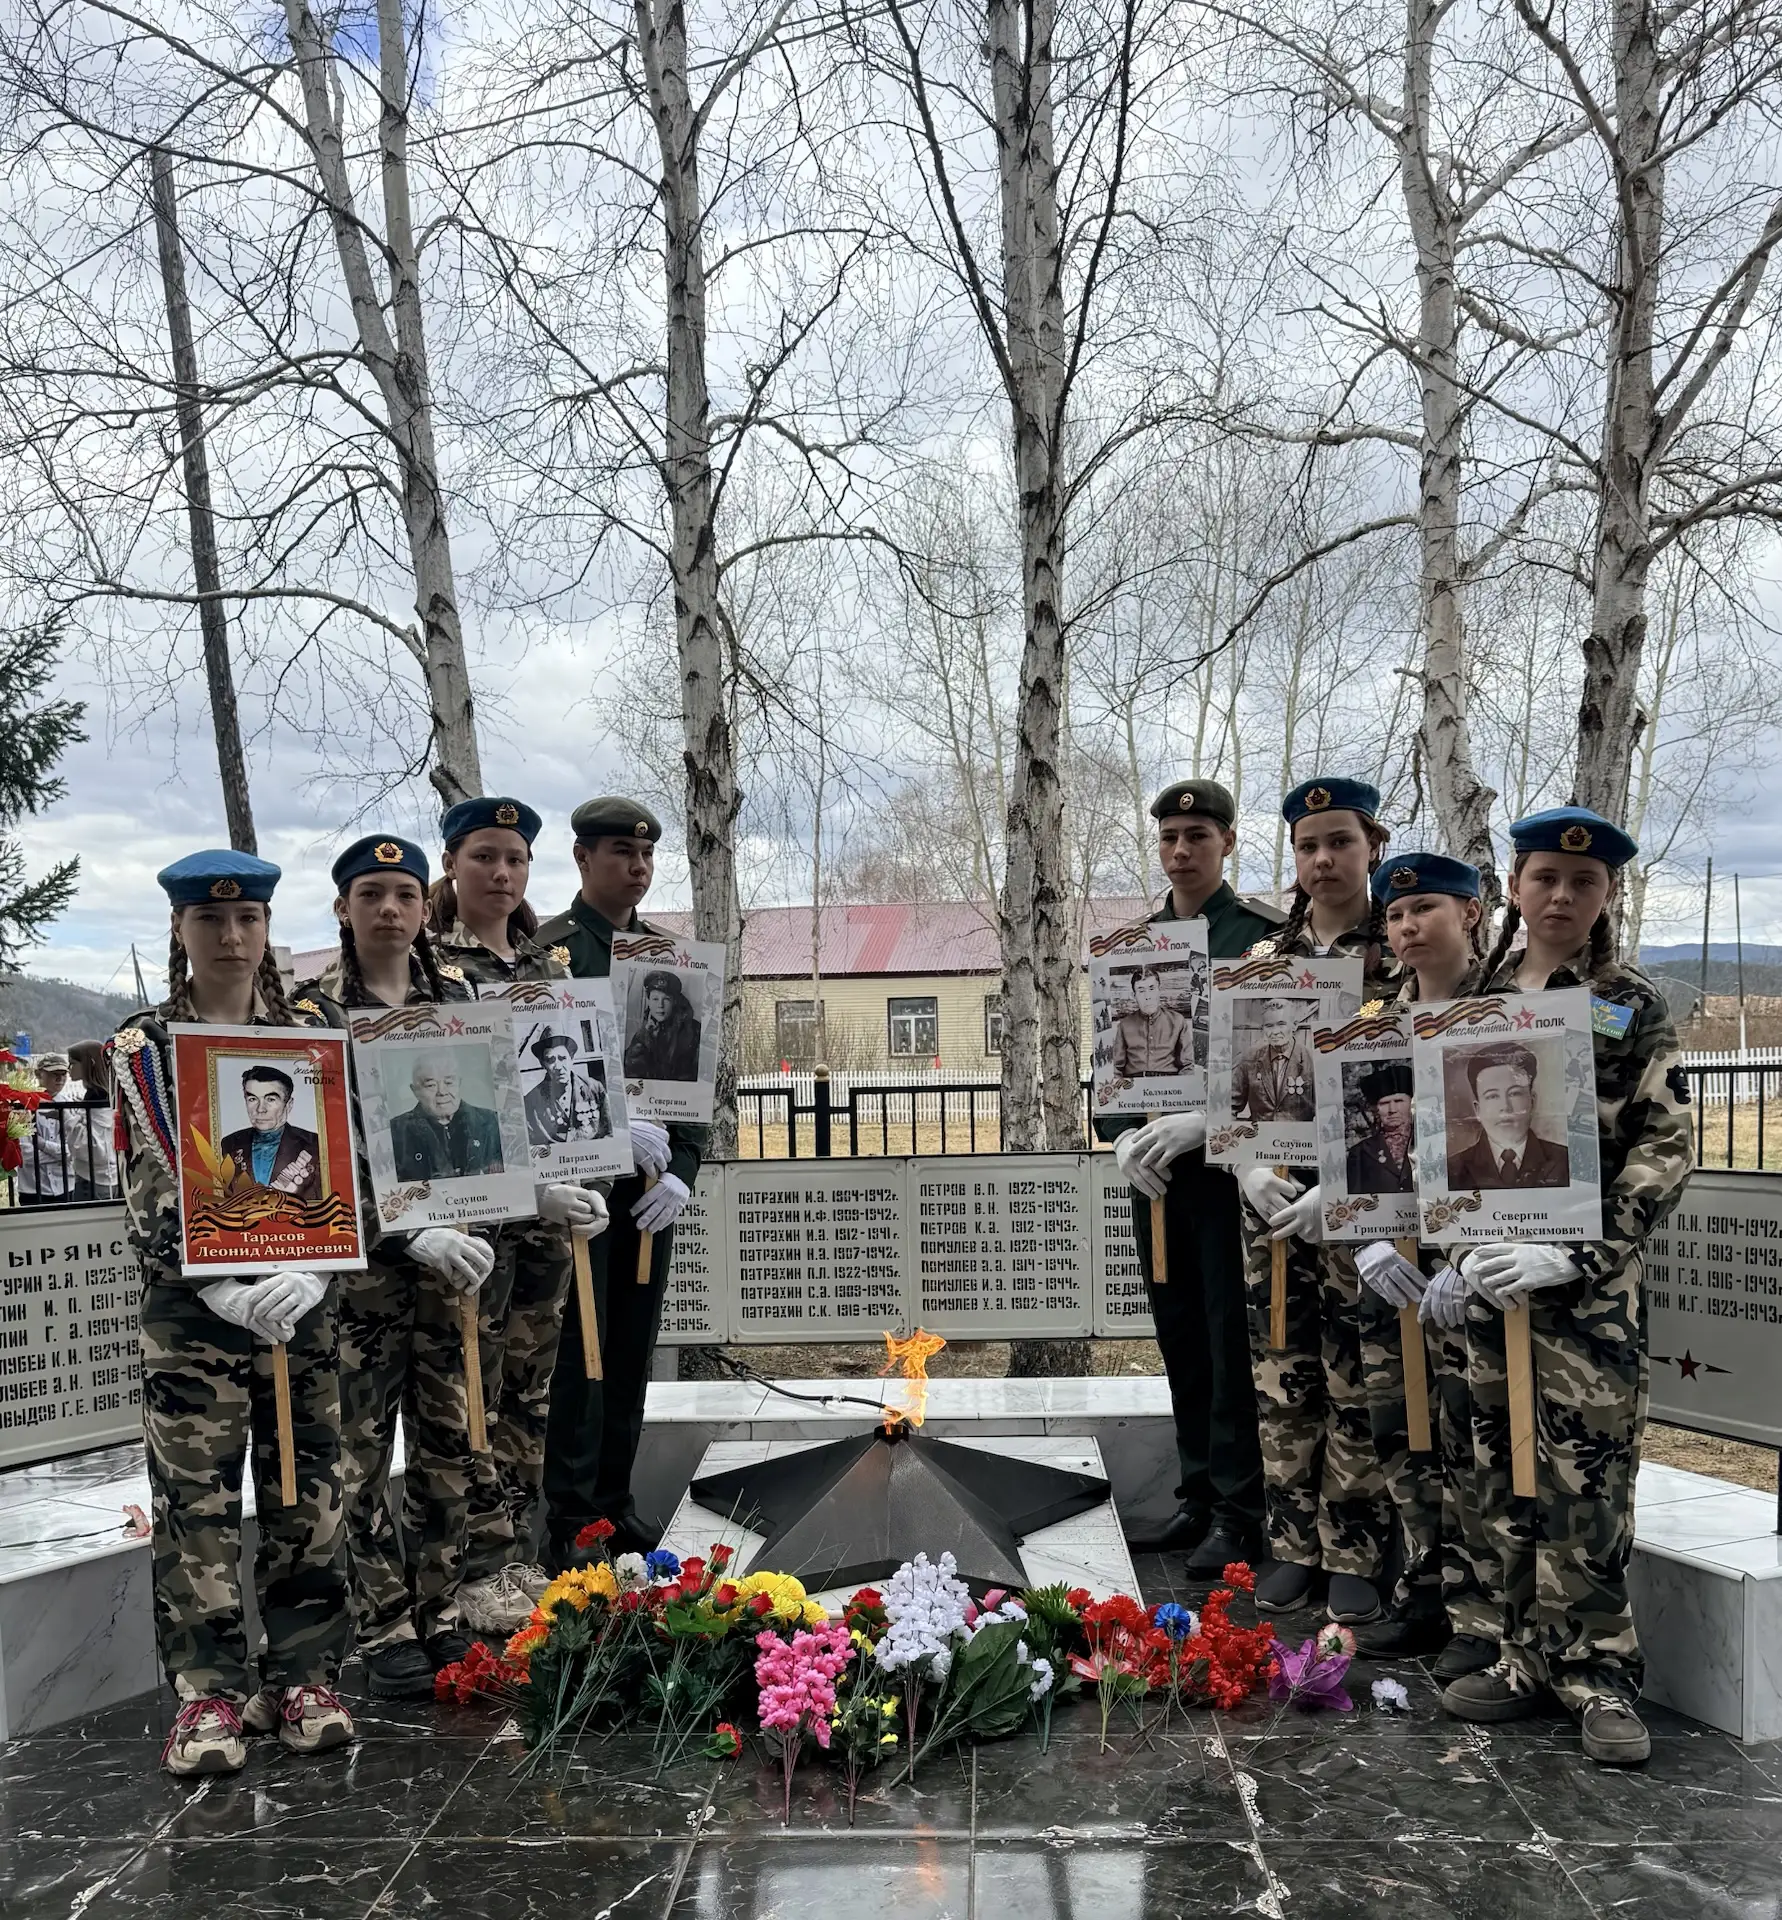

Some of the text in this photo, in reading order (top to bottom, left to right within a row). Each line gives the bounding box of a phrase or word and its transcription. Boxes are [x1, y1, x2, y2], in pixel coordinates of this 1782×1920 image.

[636, 1107, 652, 1116] Вера
[1272, 1138, 1312, 1149] Седунов
[559, 1154, 600, 1164] Патрахин
[1256, 1152, 1280, 1160] Иван
[539, 1164, 621, 1179] Андрей Николаевич
[920, 1184, 966, 1196] ПЕТРОВ
[445, 1194, 488, 1206] Седунов
[428, 1206, 509, 1221] Илья Иванович
[920, 1202, 966, 1216] ПЕТРОВ
[1394, 1210, 1420, 1219] Хме
[1492, 1211, 1548, 1222] Севергин
[920, 1222, 966, 1234] ПЕТРОВ
[1354, 1224, 1405, 1236] Григорий
[1460, 1226, 1584, 1236] Матвей Максимович
[240, 1232, 305, 1244] Тарасов
[196, 1244, 352, 1258] Леонид Андреевич
[921, 1240, 976, 1254] ПОМУЛЕВ
[922, 1260, 976, 1273] ПОМУЛЕВ
[922, 1279, 977, 1292] ПОМУЛЕВ
[922, 1298, 978, 1311] ПОМУЛЕВ
